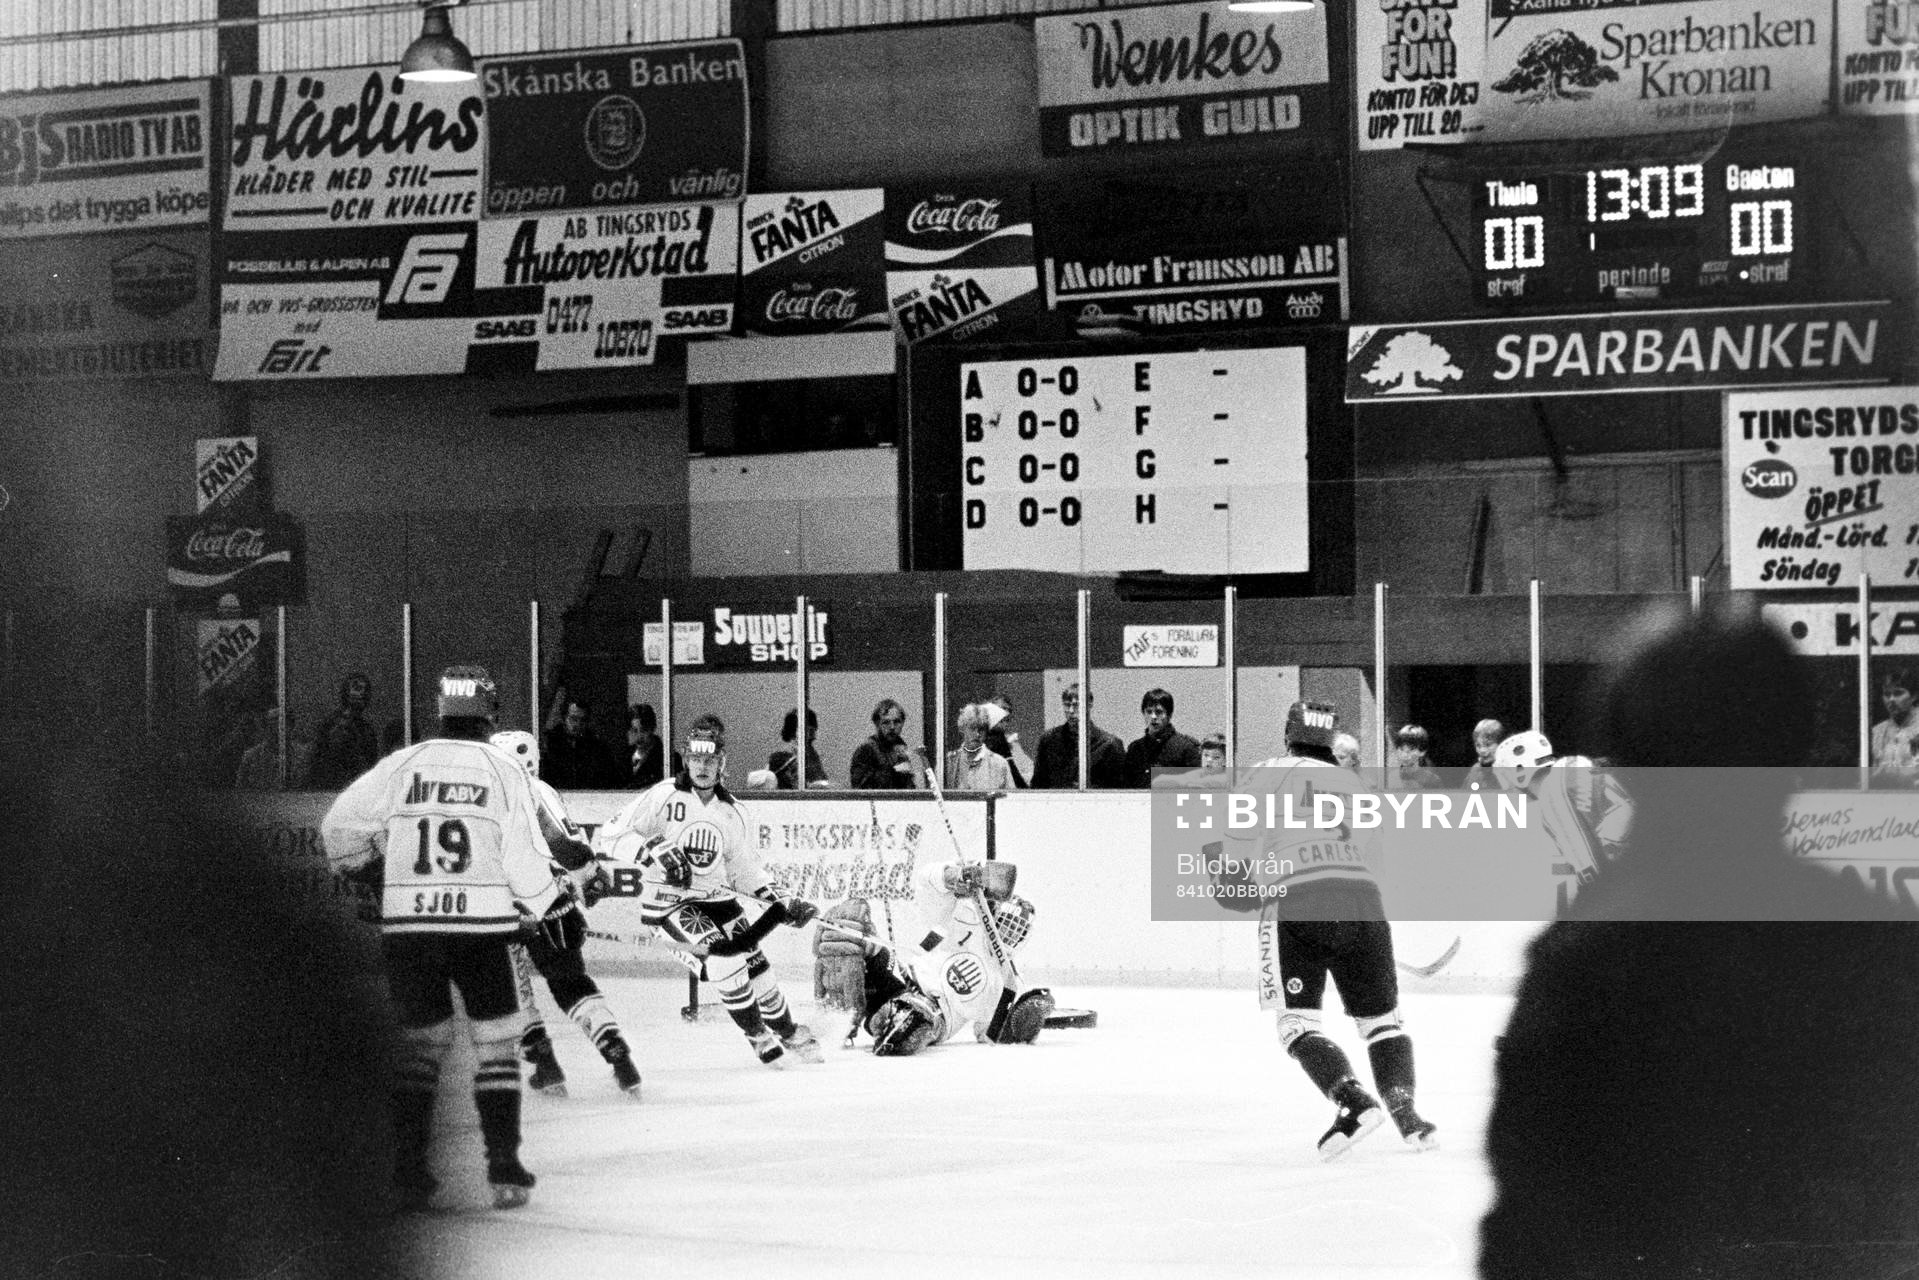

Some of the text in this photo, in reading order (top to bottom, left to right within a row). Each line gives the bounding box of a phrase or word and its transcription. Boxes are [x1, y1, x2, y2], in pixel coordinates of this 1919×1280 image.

[1387, 7, 1451, 45] FOR
[1601, 11, 1816, 69] Sparbanken
[1073, 12, 1282, 89] Wemkes
[1382, 41, 1457, 82] FUN!
[484, 53, 743, 98] Skånska Banken
[1640, 60, 1771, 99] Kronan
[1367, 82, 1479, 112] KONTO FÖR DEJ
[233, 71, 482, 167] Härlins
[1069, 95, 1300, 147] OPTIK GULD
[1368, 114, 1399, 140] UPP
[1403, 112, 1435, 137] TILL
[66, 119, 135, 164] RADIO
[171, 115, 201, 154] AB
[235, 165, 428, 196] KLÄDER MED STIL
[491, 168, 742, 207] öppen och vänlig
[1587, 164, 1704, 222] 13:09
[86, 197, 150, 223] trygga
[330, 198, 374, 221] OCH
[564, 200, 691, 230] AB TINGSRYDS
[907, 199, 1001, 234] Coca-Cola
[1731, 200, 1793, 256] 00
[504, 205, 714, 285] Autoverkstad
[751, 200, 840, 263] FANTA
[799, 234, 845, 263] CITRON
[1484, 215, 1545, 271] 00
[370, 257, 390, 269] AB
[1061, 245, 1334, 290] Motor Fransson AB
[547, 295, 593, 334] 0477
[766, 289, 859, 322] Coca-Cola
[899, 278, 993, 341] FANTA
[1133, 297, 1263, 325] TINGSRYD
[1286, 292, 1324, 306] Audi
[474, 320, 536, 339] SAAB
[664, 309, 729, 330] SAAB
[595, 320, 653, 359] 10870
[1493, 318, 1879, 380] SPARBANKEN
[965, 370, 983, 400] A
[1017, 366, 1079, 398] 0-0
[1135, 362, 1151, 392] E
[965, 413, 984, 442] B
[1018, 408, 1079, 440] 0-0
[1135, 405, 1151, 436] F
[1739, 403, 1919, 440] TINGSRYDS
[200, 440, 255, 499] FANTA
[966, 456, 985, 486] C
[1019, 452, 1080, 484] 0-0
[1136, 449, 1156, 479] G
[1744, 467, 1795, 488] Scan
[1829, 443, 1919, 476] TORG
[966, 499, 986, 529] D
[1019, 496, 1081, 527] 0-0
[1136, 494, 1156, 524] H
[1805, 479, 1881, 522] ÖPPET
[1760, 557, 1842, 586] Söndag
[441, 678, 477, 697] VIVO
[1305, 711, 1334, 730] VIVO
[690, 740, 716, 754] VIVO
[444, 786, 483, 802] ABV
[667, 802, 686, 822] 10
[413, 818, 471, 875] 19
[759, 823, 896, 850] B TINGSRYDS
[1298, 843, 1362, 864] CARLSS
[413, 888, 467, 914] SJÖÖ
